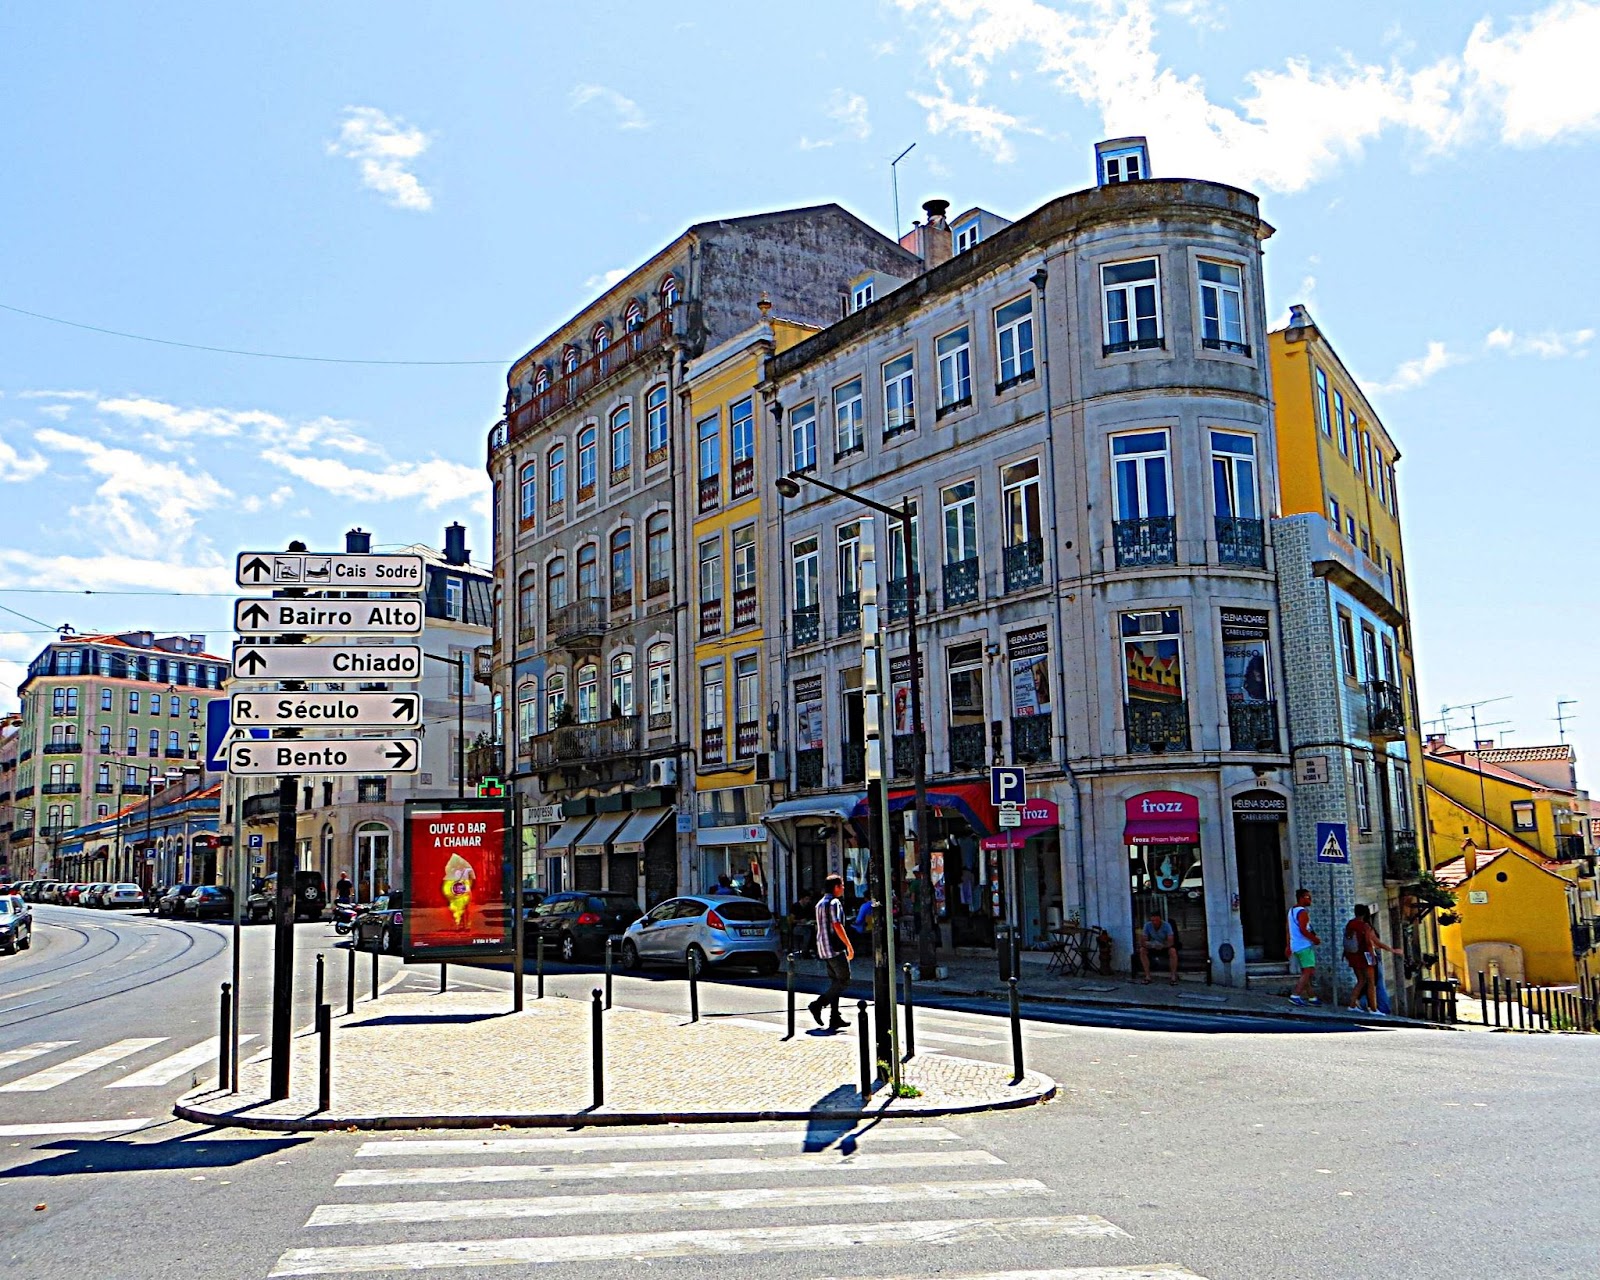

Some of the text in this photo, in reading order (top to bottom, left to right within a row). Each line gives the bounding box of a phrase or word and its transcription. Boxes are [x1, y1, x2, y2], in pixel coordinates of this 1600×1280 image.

[335, 564, 418, 579] Cais Sodré
[280, 607, 416, 625] Bairro Alto
[1243, 616, 1267, 624] SOARES
[1009, 634, 1028, 645] HELENA
[1225, 629, 1263, 637] CABELEIREIRO
[333, 653, 415, 671] Chiado
[236, 700, 359, 719] R. Século
[234, 748, 347, 767] S. Bento
[1000, 772, 1018, 800] P
[1141, 798, 1183, 813] frozz
[1233, 799, 1285, 808] HELENA SOARES
[528, 805, 554, 823] progresso
[1022, 806, 1049, 820] frozz
[429, 823, 486, 834] OUVE O BAR
[251, 836, 260, 846] P
[434, 836, 481, 848] A CHAMAR
